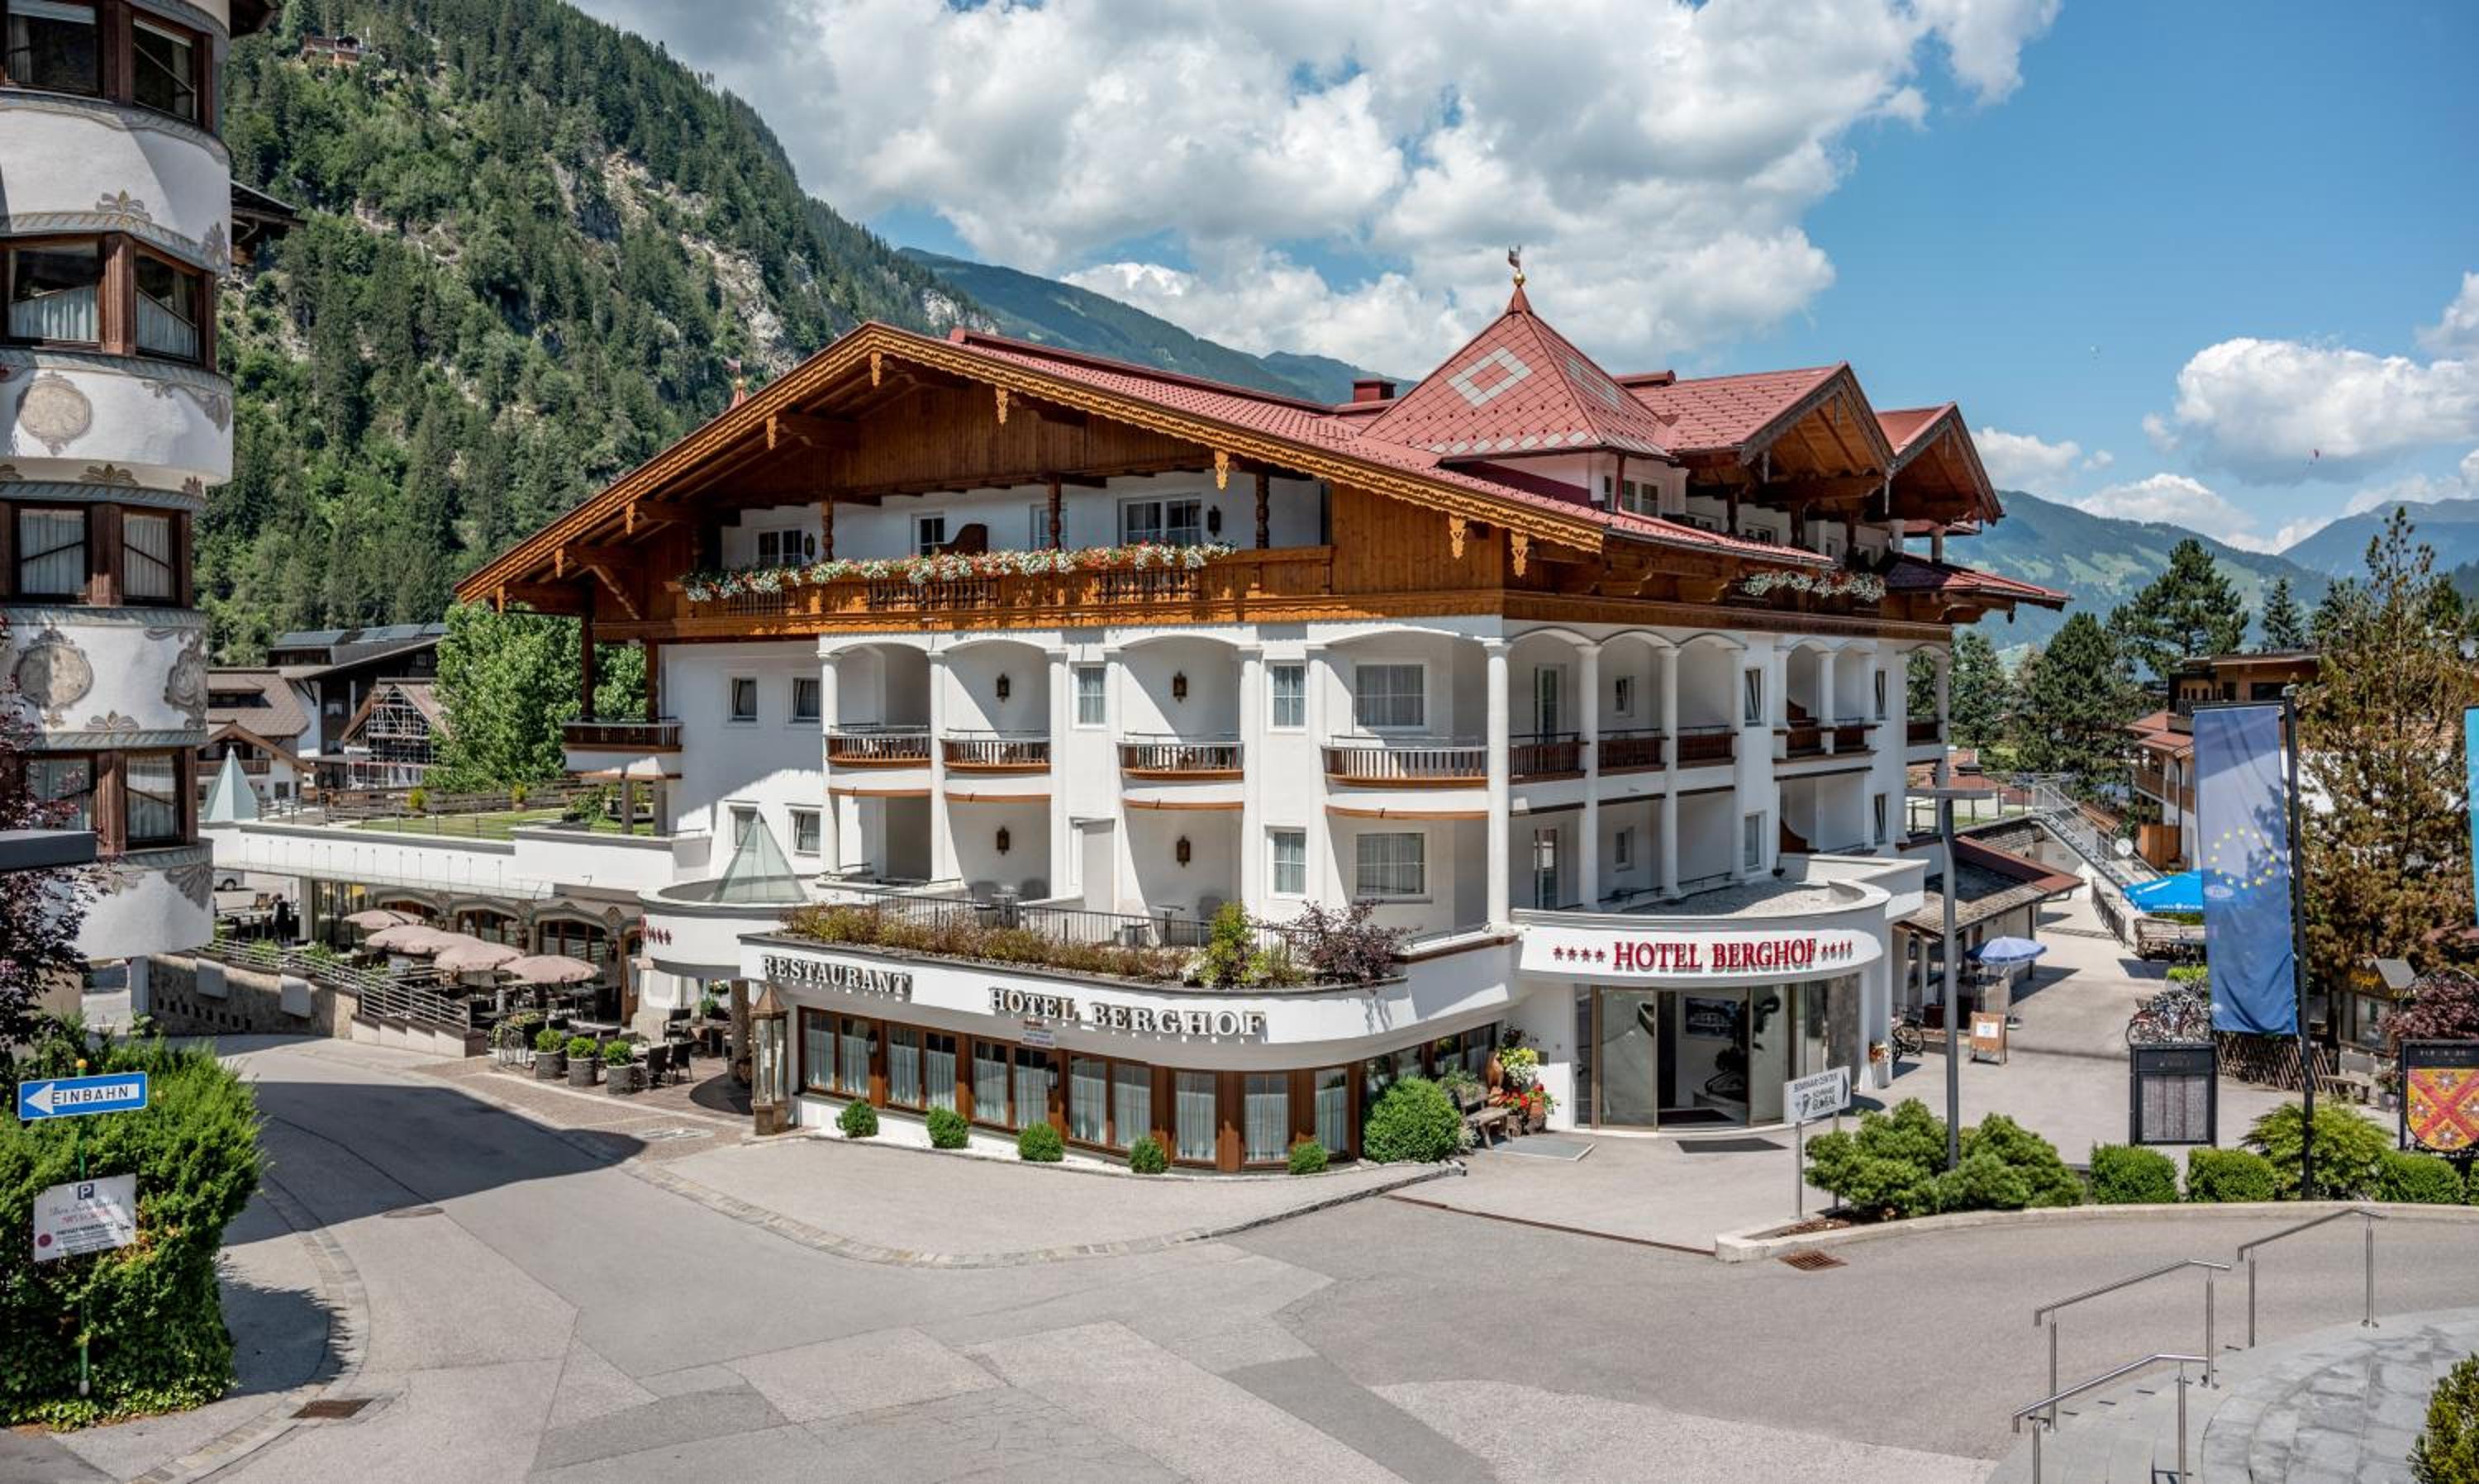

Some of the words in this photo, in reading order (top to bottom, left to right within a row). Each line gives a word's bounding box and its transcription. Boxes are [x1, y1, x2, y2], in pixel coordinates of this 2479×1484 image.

[1614, 941, 1703, 970] HOTEL
[1711, 938, 1817, 969] BERGHOF
[762, 955, 909, 996] RESTAURANT
[988, 988, 1076, 1020] HOTEL
[1091, 1001, 1266, 1036] BERGHOF
[52, 1086, 128, 1105] EINBAHN
[80, 1186, 92, 1200] P
